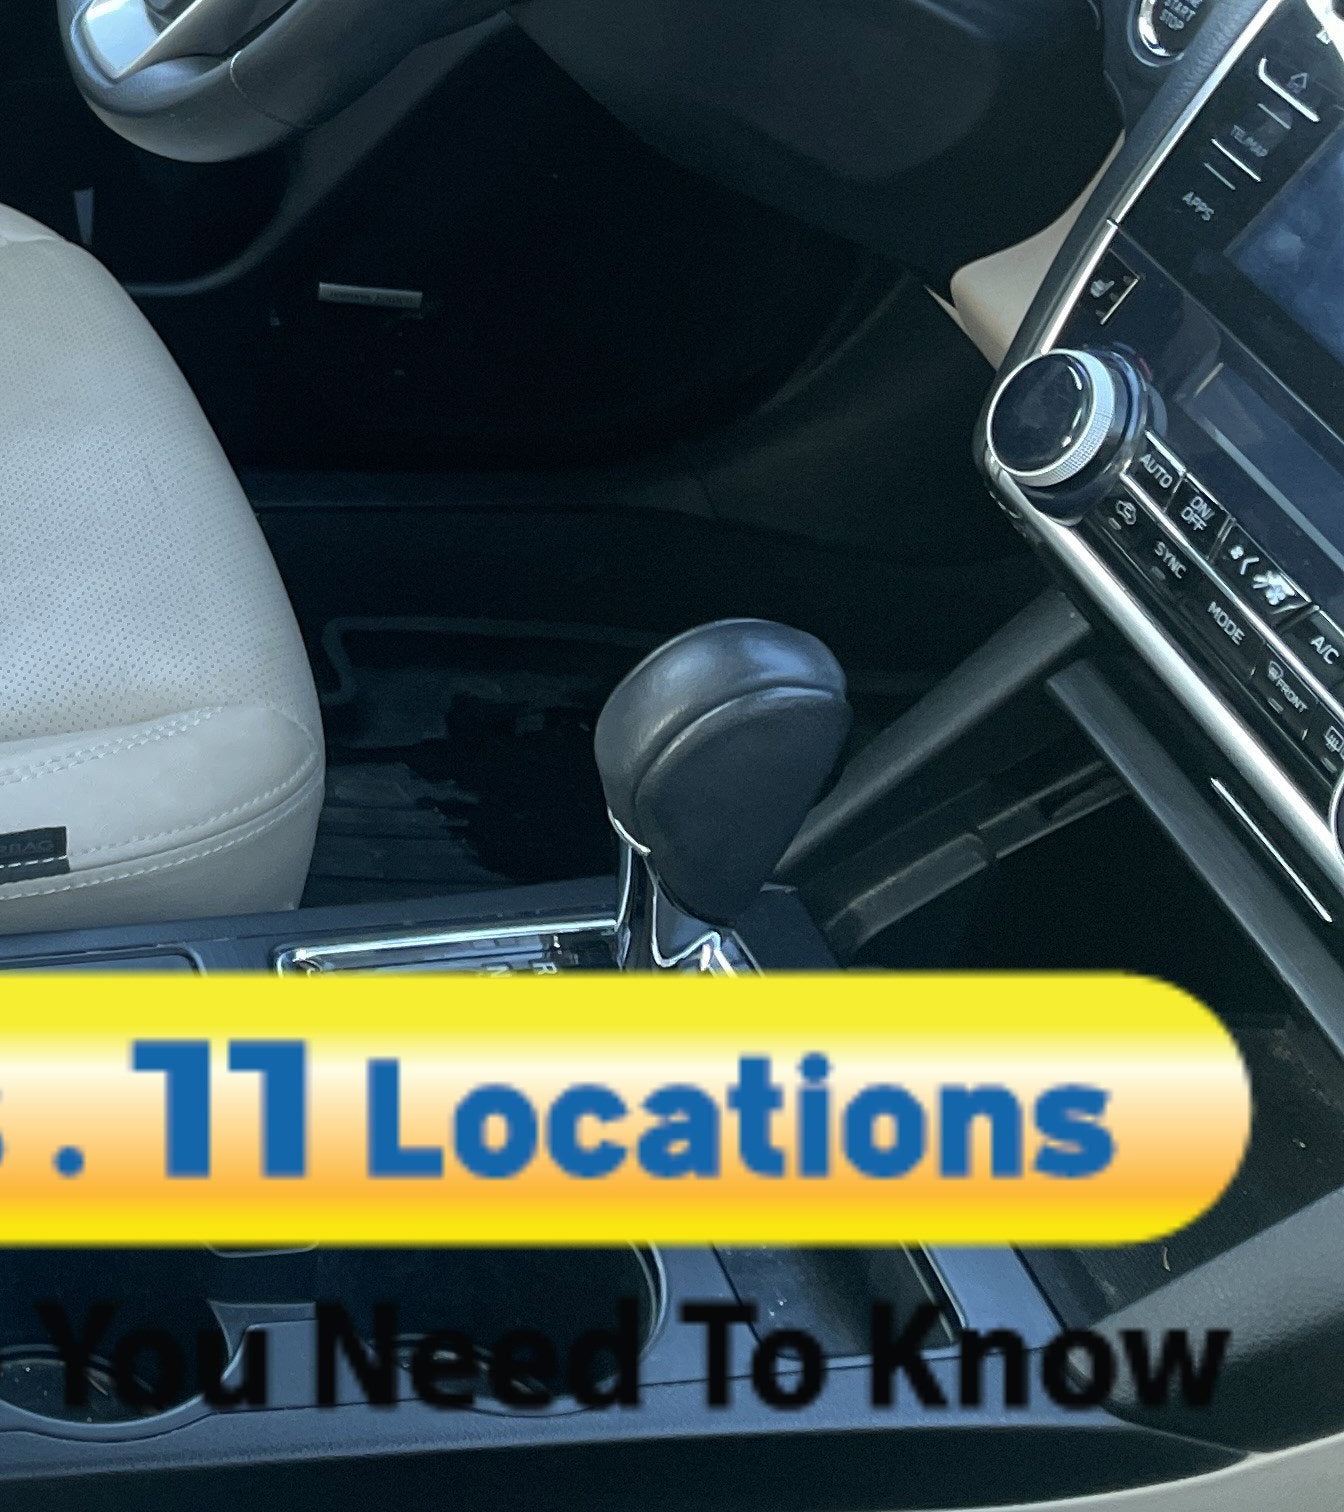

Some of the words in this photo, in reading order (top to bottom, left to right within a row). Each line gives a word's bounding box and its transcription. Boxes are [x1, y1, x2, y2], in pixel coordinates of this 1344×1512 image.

[1182, 191, 1214, 221] APPS
[1139, 453, 1173, 488] AUTO
[1180, 506, 1207, 531] OFF
[1154, 541, 1187, 579] SYNC
[1207, 601, 1245, 646] MODE
[1310, 636, 1340, 665] A/C
[1275, 678, 1308, 713] FRONT
